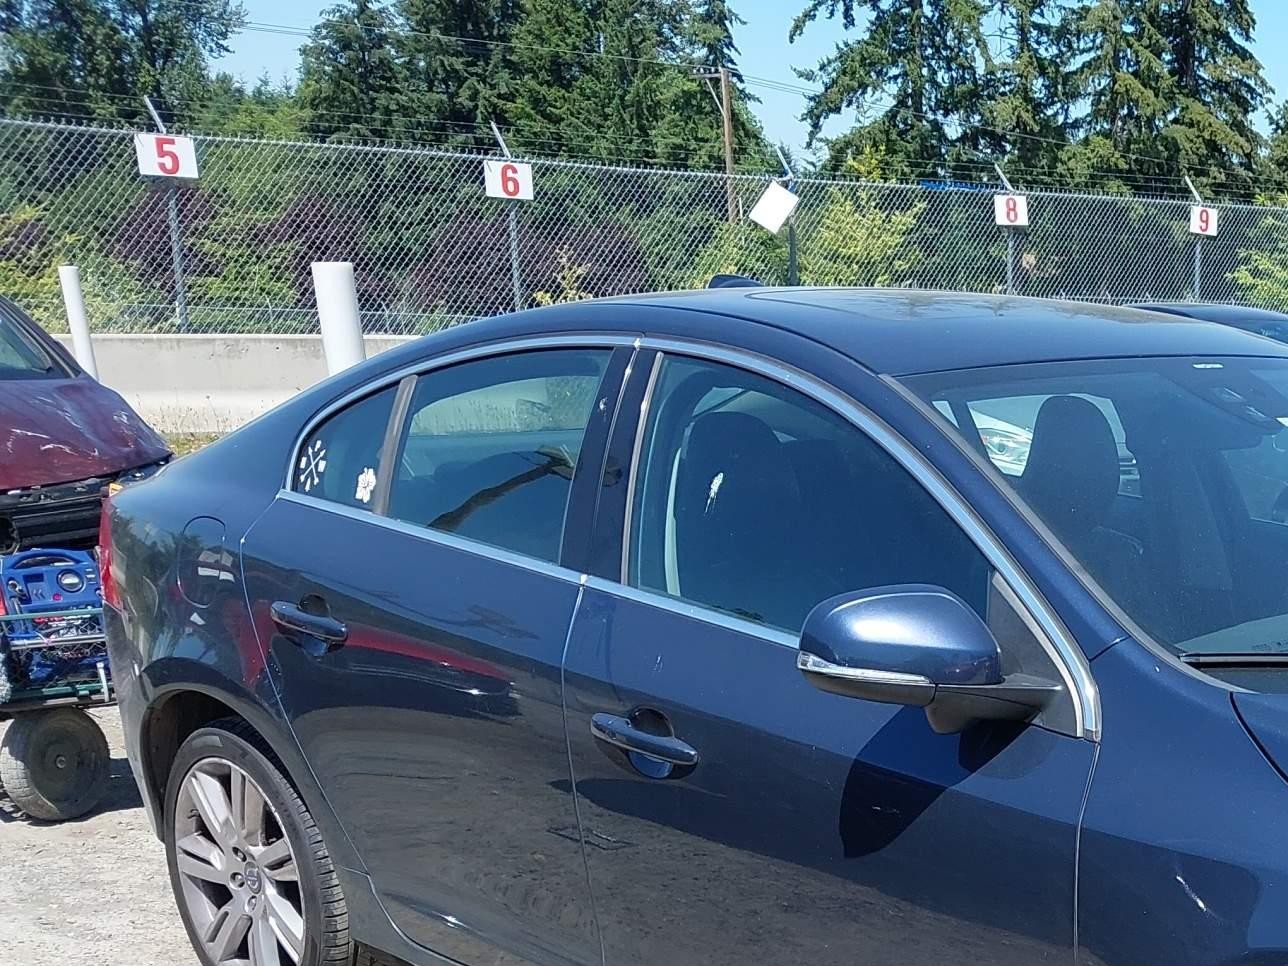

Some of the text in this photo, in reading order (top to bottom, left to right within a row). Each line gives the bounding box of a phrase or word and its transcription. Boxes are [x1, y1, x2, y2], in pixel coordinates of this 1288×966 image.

[155, 136, 181, 176] 5
[500, 163, 521, 198] 6
[1005, 196, 1019, 223] 8
[1200, 208, 1211, 232] 9
